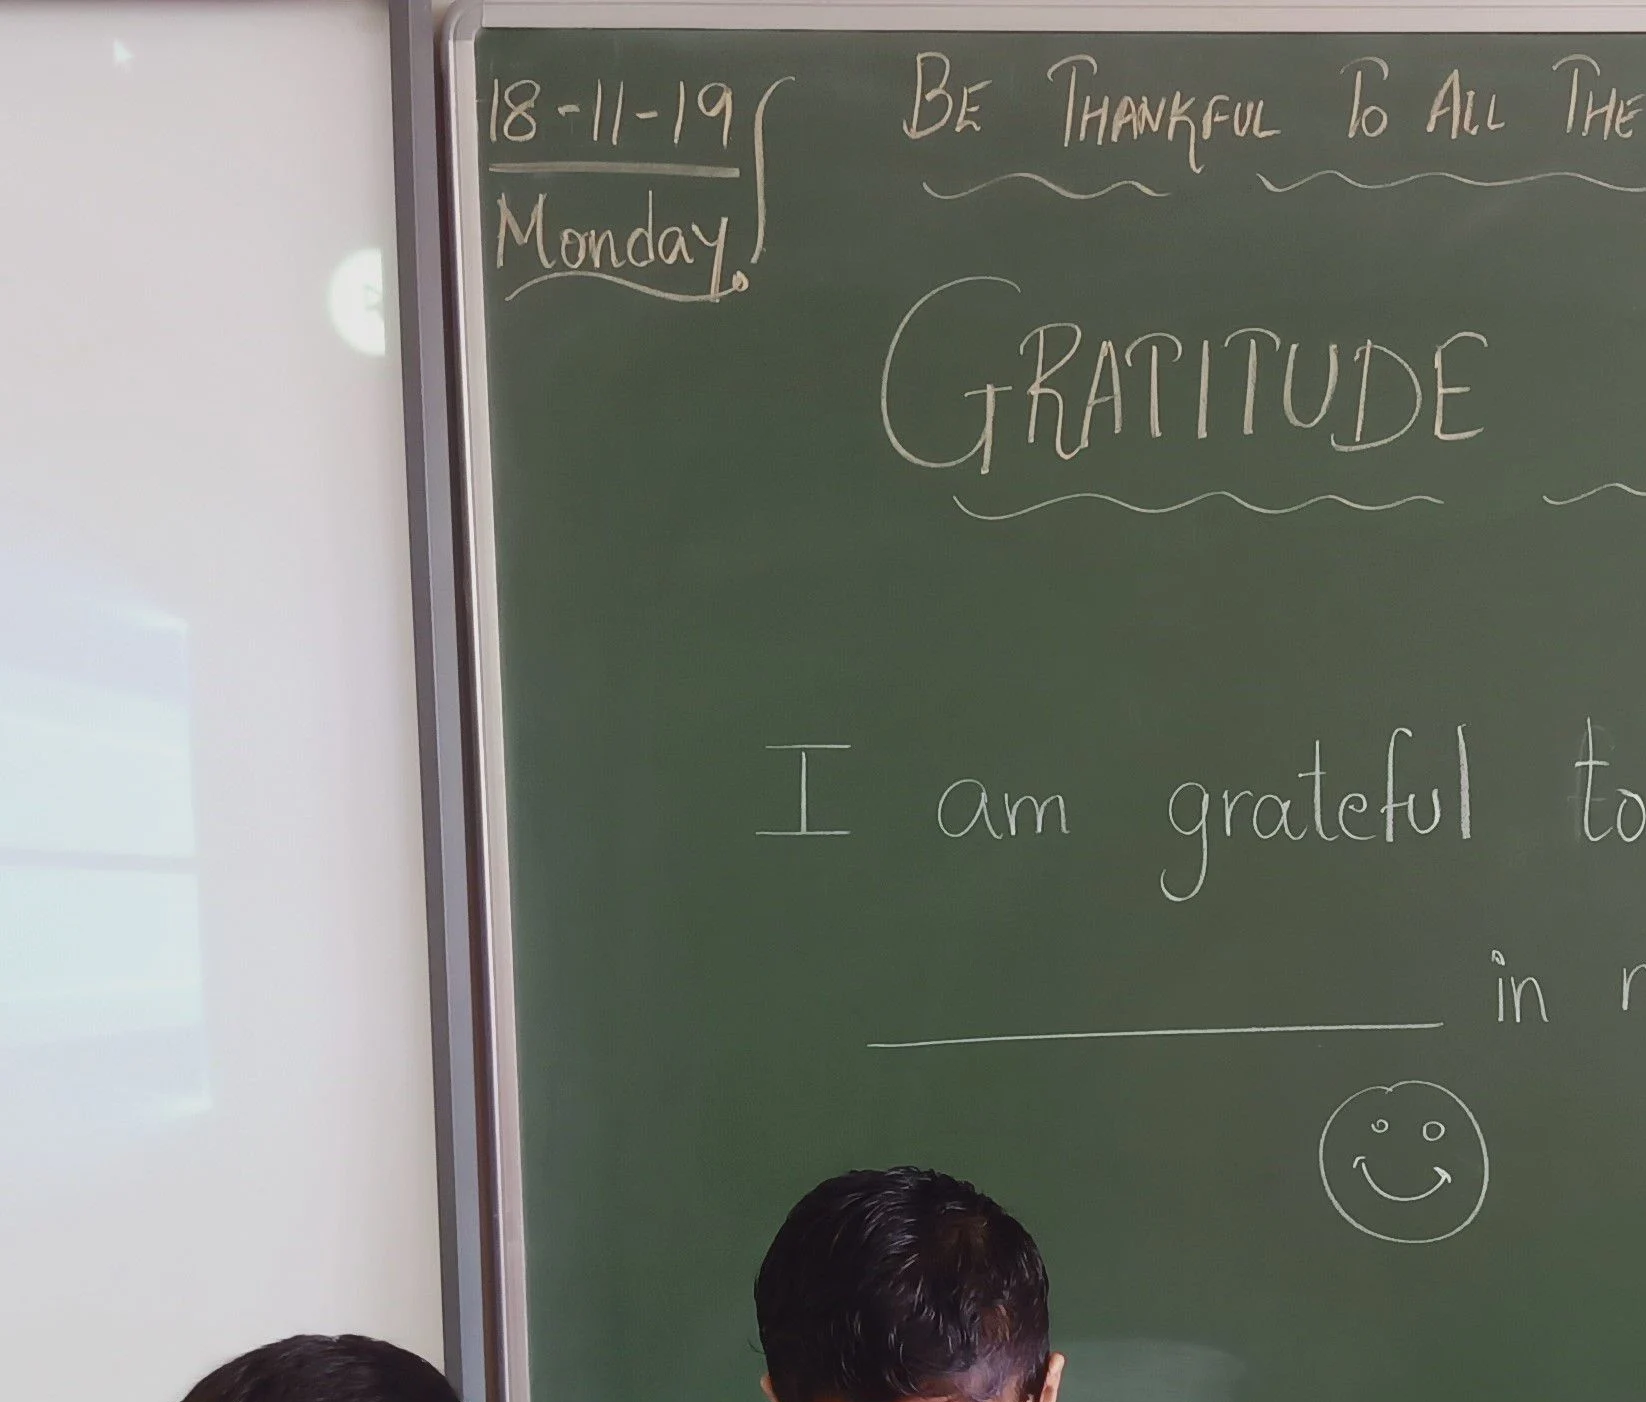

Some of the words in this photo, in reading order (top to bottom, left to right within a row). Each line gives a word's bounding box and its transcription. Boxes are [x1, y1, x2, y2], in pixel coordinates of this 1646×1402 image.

[488, 77, 735, 150] 18-11-19
[903, 52, 993, 141] BE
[1047, 54, 1281, 174] THANKFUL
[1339, 55, 1390, 138] TO
[1425, 68, 1506, 139] ALL
[1551, 53, 1646, 142] THE
[880, 275, 1488, 474] GRATITUDE
[756, 743, 852, 838] I
[936, 777, 1071, 840] am
[1160, 723, 1473, 902] grateful
[1493, 946, 1549, 1025] in
